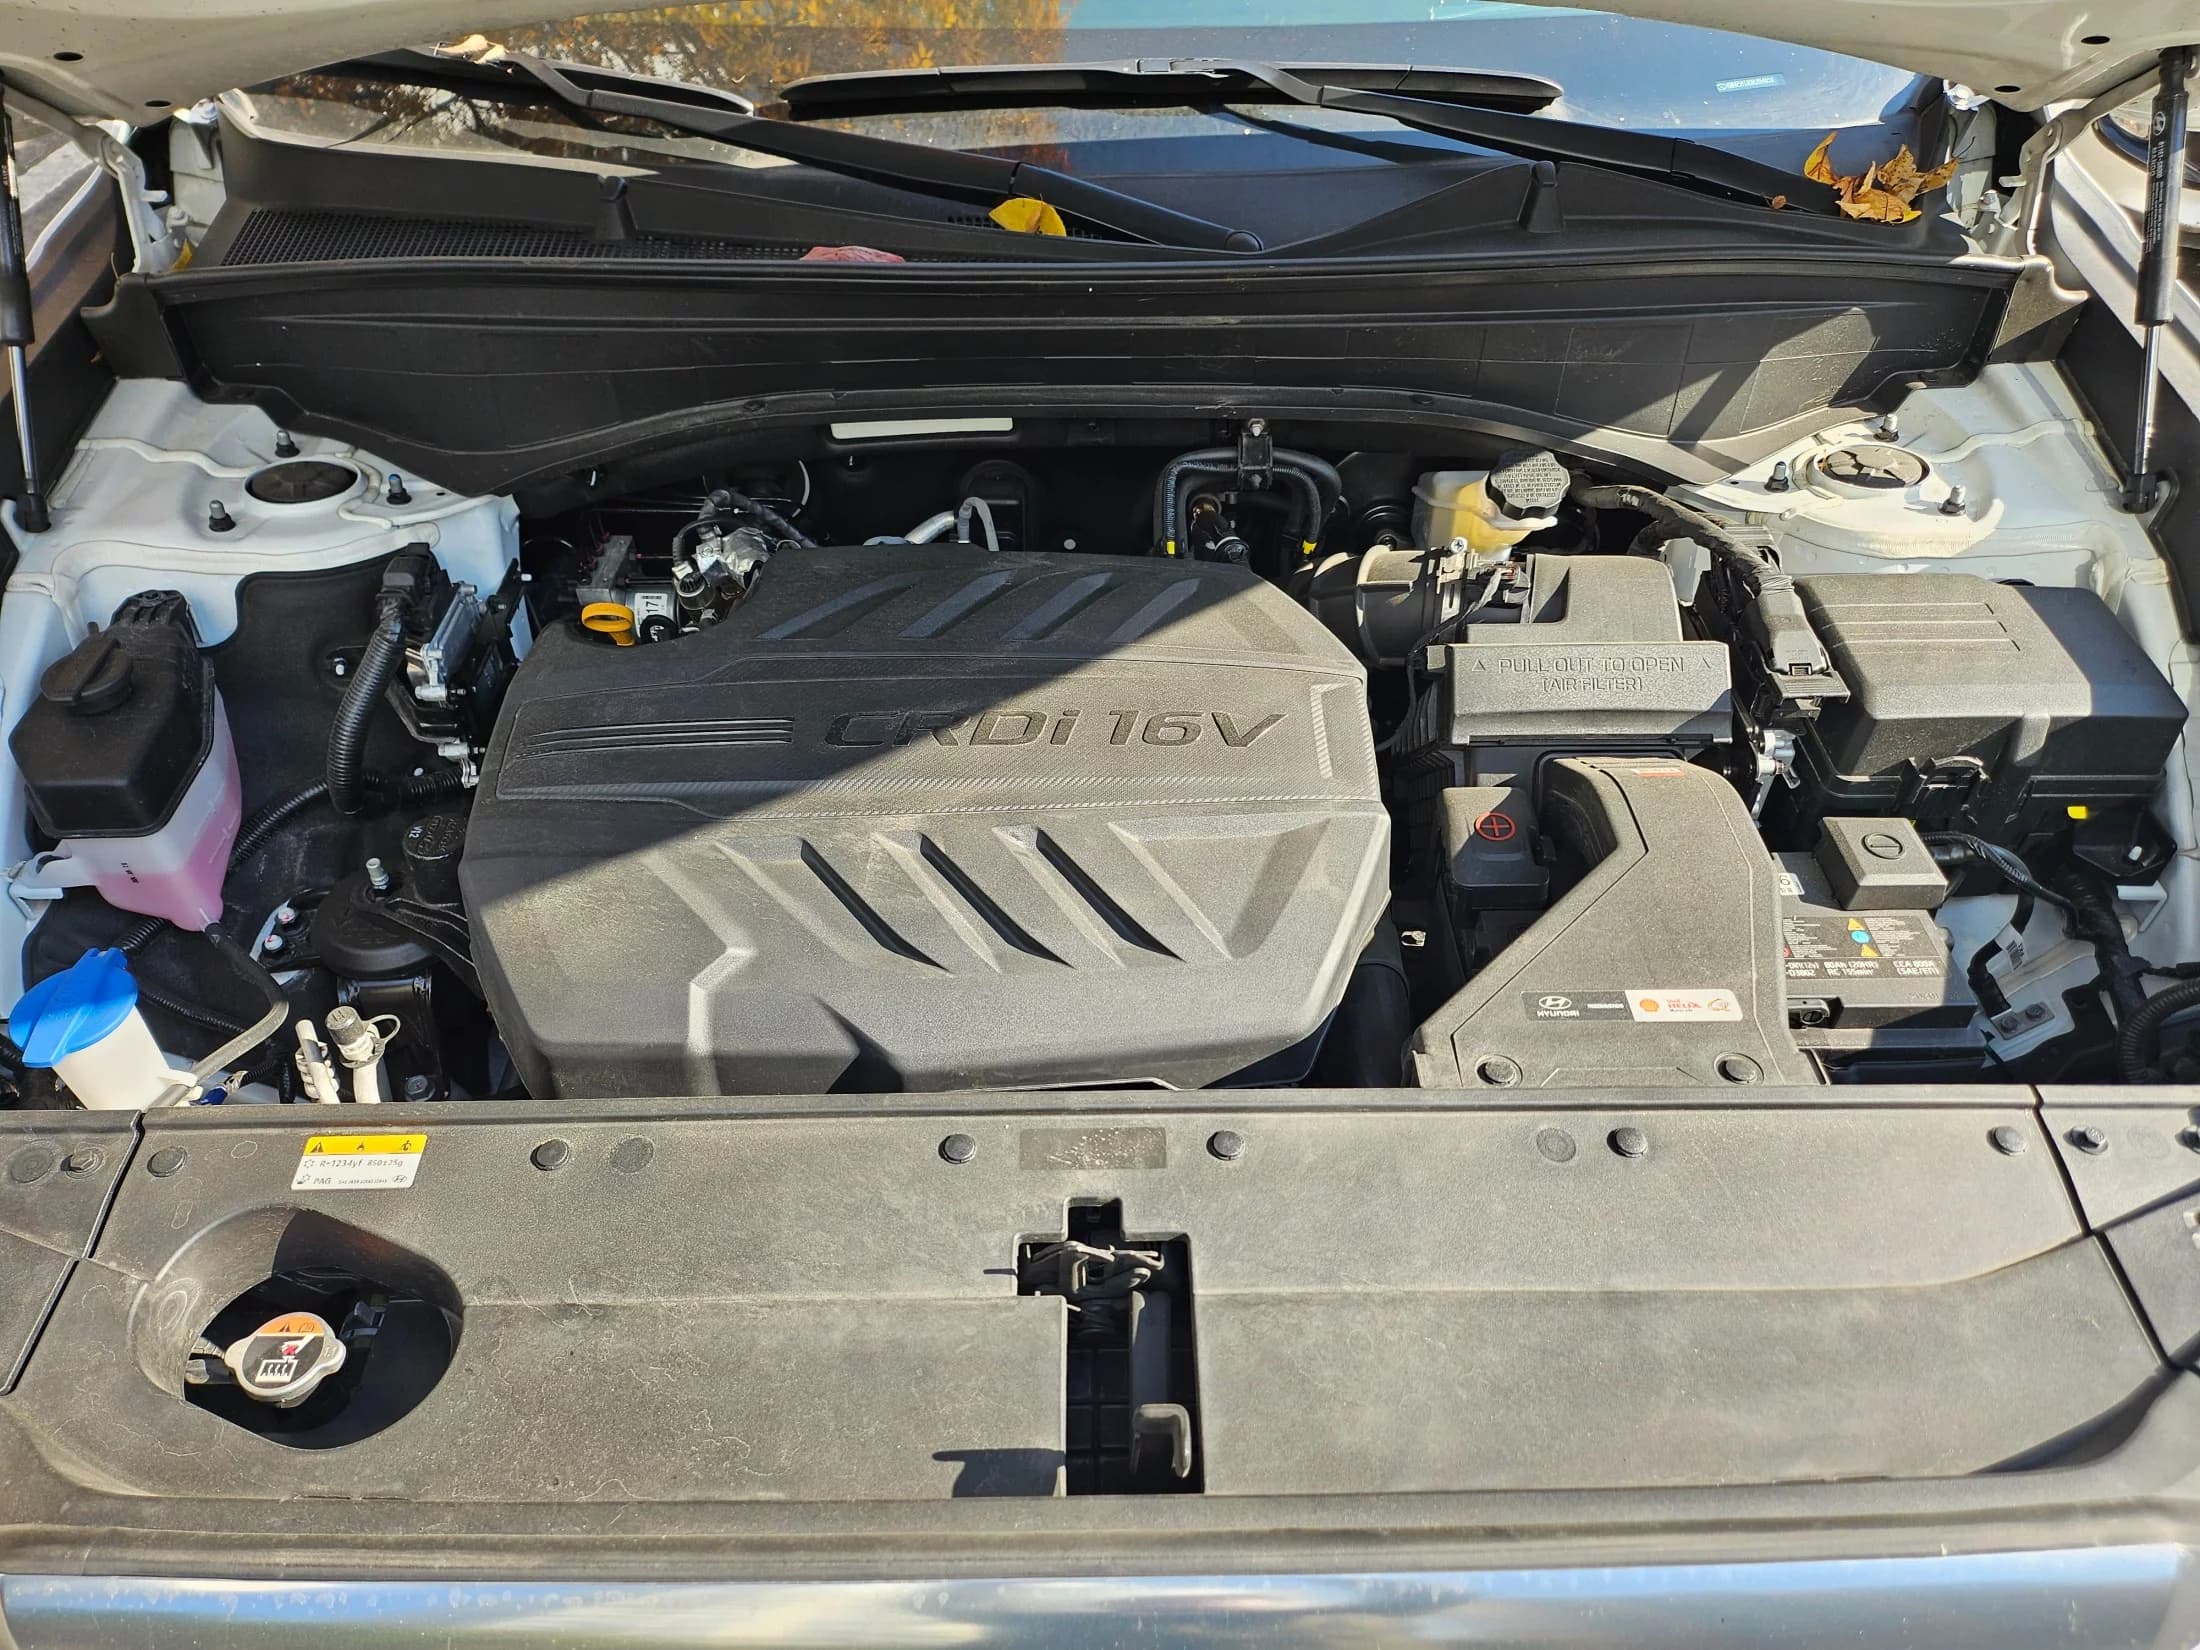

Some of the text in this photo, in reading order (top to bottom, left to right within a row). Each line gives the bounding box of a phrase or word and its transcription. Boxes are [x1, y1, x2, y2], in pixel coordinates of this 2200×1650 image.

[1498, 656, 1685, 674] PULL OUT TO OPEN
[824, 708, 1289, 748] CRDi 16V
